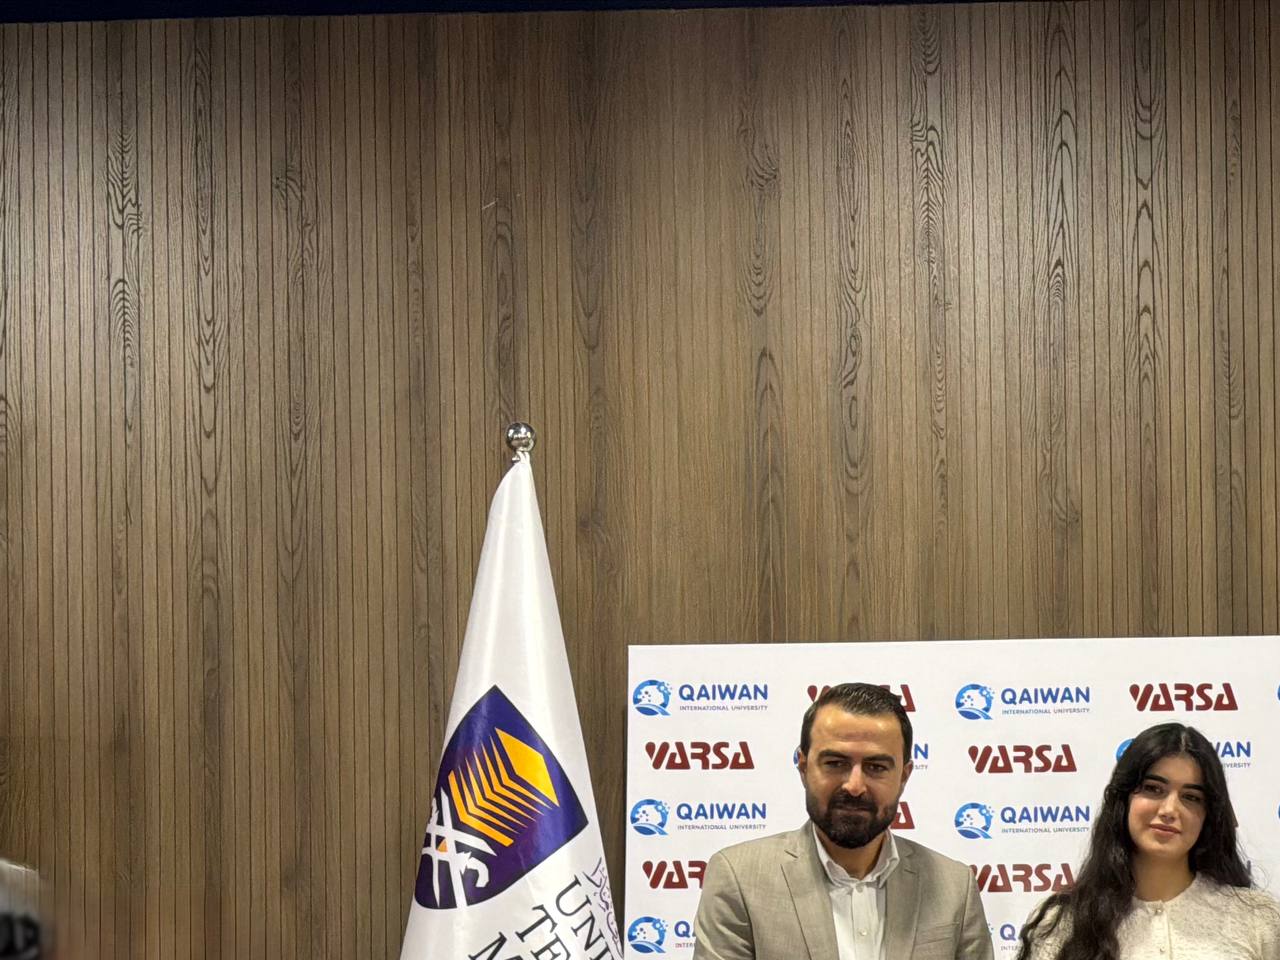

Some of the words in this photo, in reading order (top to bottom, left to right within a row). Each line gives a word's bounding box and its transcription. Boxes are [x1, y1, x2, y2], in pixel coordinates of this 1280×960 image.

[679, 684, 768, 702] QAIWAN
[1001, 687, 1090, 705] QAIWAN
[1130, 682, 1238, 712] VARSA
[645, 742, 755, 770] VARSA
[968, 745, 1077, 774] VARSA
[676, 803, 766, 820] QAIWAN
[1001, 806, 1090, 824] QAIWAN
[642, 861, 705, 889] VAR
